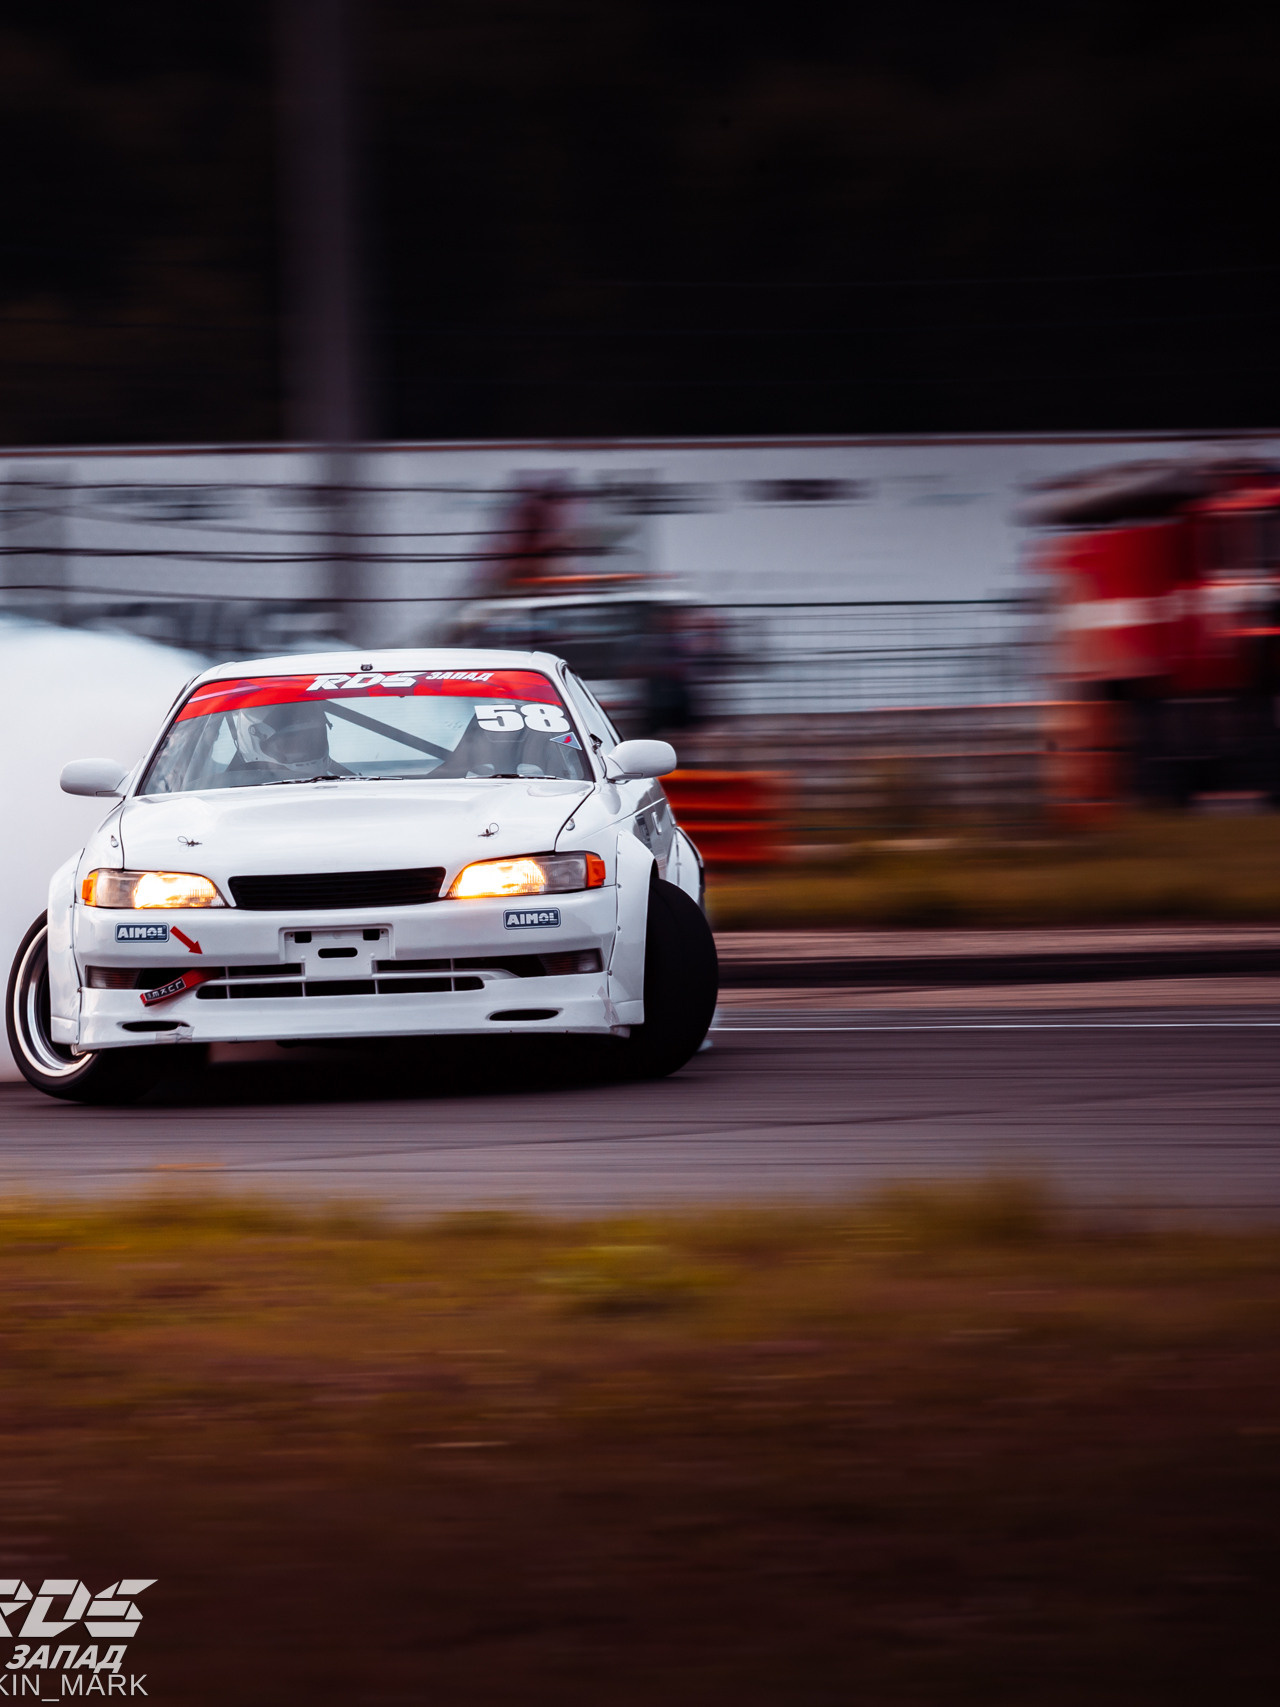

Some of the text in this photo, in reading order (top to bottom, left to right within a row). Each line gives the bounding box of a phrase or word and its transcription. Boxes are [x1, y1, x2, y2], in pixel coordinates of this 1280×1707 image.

[306, 671, 495, 691] RDS ЗАПАД
[474, 704, 571, 732] 58
[507, 912, 558, 925] AIMOL
[117, 927, 166, 938] AIMOL
